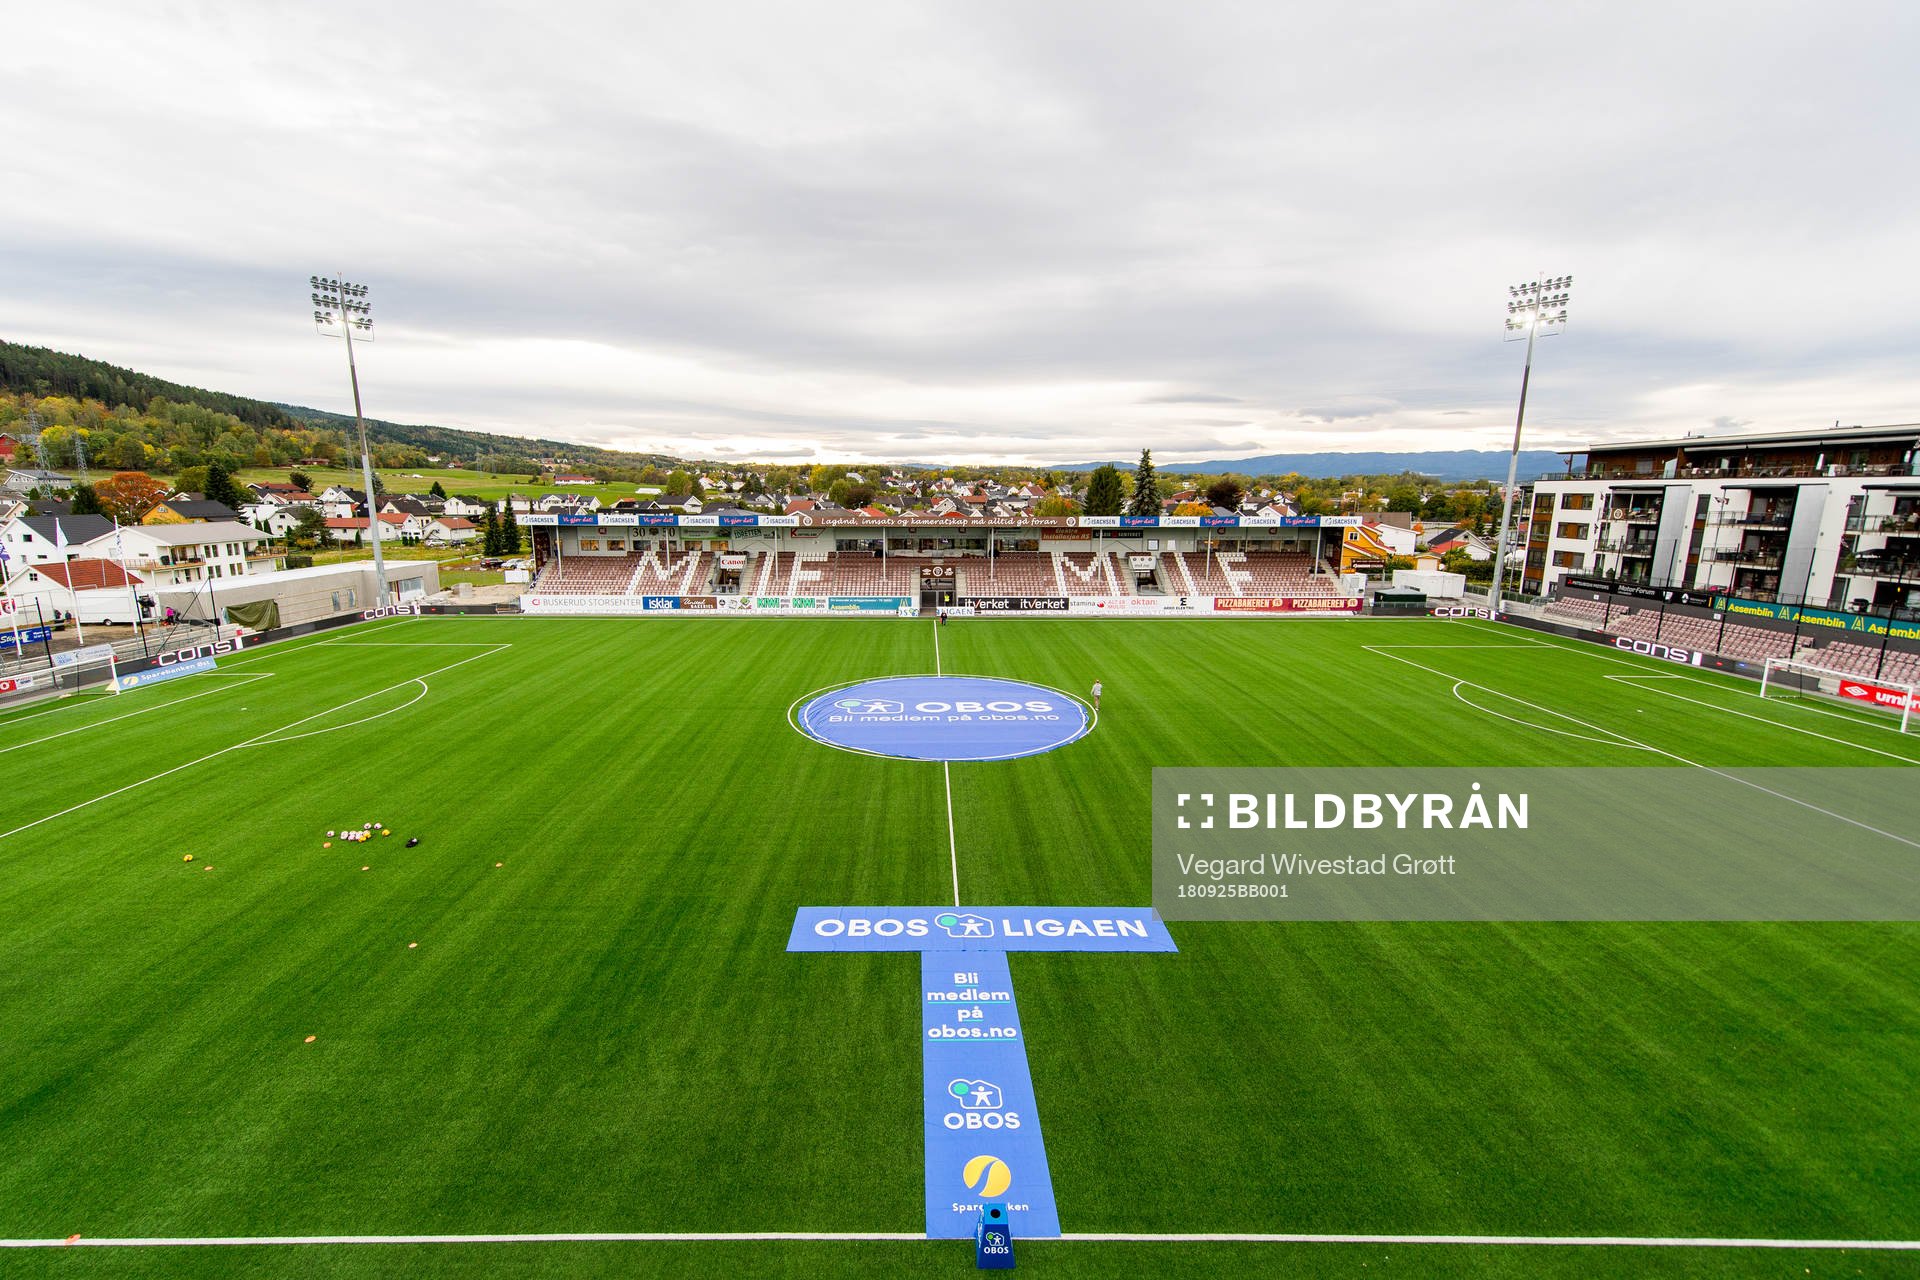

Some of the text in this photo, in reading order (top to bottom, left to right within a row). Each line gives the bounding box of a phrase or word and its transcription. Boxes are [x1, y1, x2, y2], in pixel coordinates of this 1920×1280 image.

[861, 517, 895, 526] innsats
[897, 519, 907, 527] og
[911, 517, 968, 527] kameratskap
[971, 517, 985, 525] må
[988, 517, 1015, 525] alltid
[1017, 517, 1029, 527] gå
[1031, 517, 1057, 527] foran
[648, 599, 674, 609] isklar
[757, 598, 779, 608] KIWI
[793, 598, 815, 608] KIWI
[1020, 599, 1065, 609] itverket
[1217, 599, 1269, 608] PIZZABAKEREN
[1293, 599, 1344, 608] PIZZABAKEREN
[1727, 603, 1774, 618] Assemblin
[1792, 612, 1846, 629] Assemblin
[140, 659, 210, 681] Sparebanken Øst
[915, 701, 1053, 713] OBOS
[949, 714, 973, 725] på
[979, 714, 1060, 722] obos.no
[815, 918, 1149, 939] OBOS LIGAEN
[954, 973, 978, 985] Bli
[927, 990, 1010, 1001] medlem
[958, 1005, 984, 1022] på
[928, 1025, 1017, 1038] obos.no
[944, 1112, 1021, 1131] OBOS
[953, 1202, 1029, 1214] Sparken
